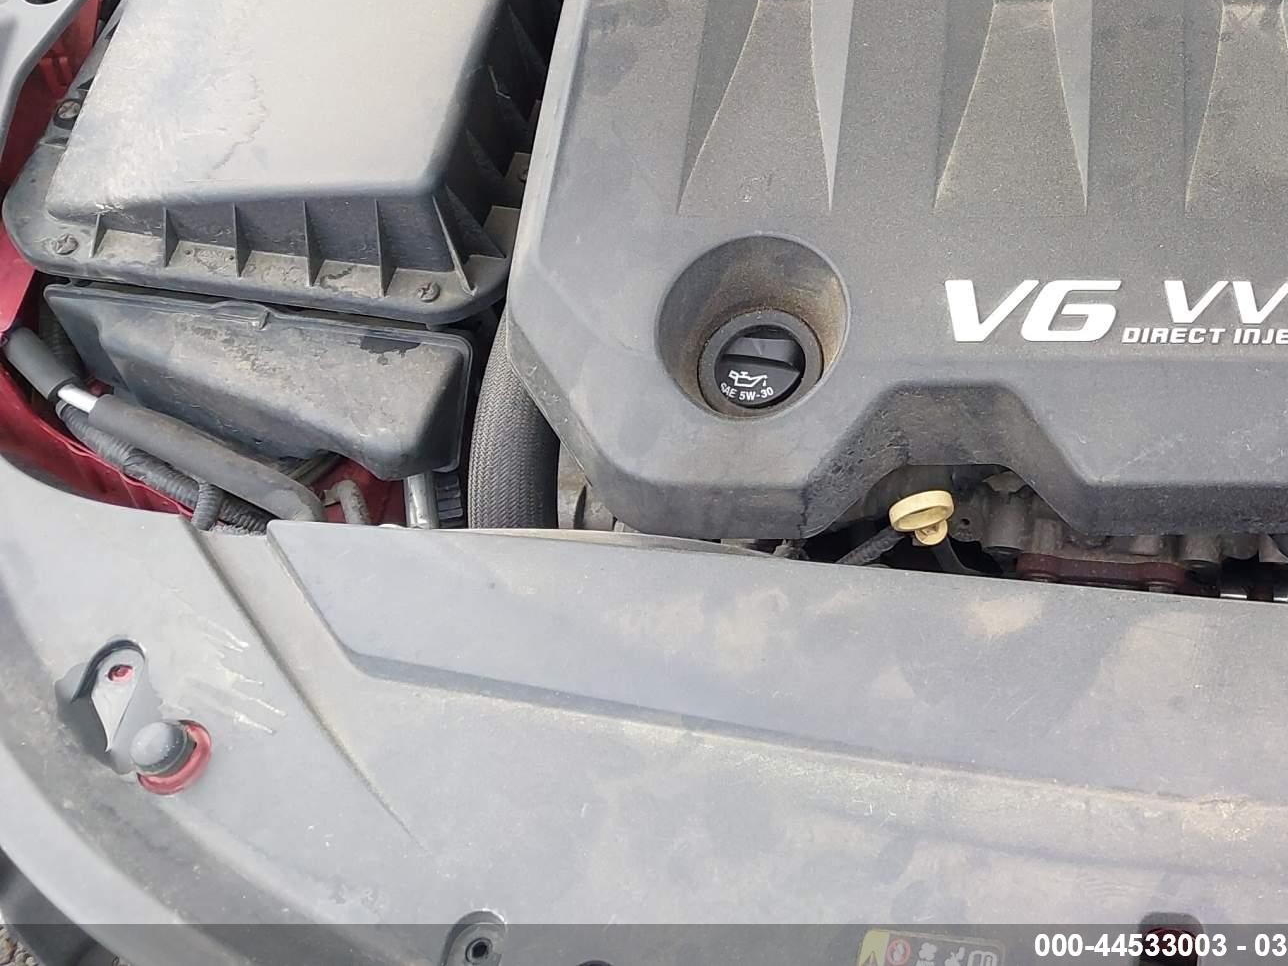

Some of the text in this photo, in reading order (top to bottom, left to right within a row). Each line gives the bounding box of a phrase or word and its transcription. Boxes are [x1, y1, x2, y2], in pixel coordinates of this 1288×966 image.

[944, 279, 1122, 342] V6
[1121, 327, 1226, 345] DIRECT
[720, 382, 774, 401] SAE 5W-30
